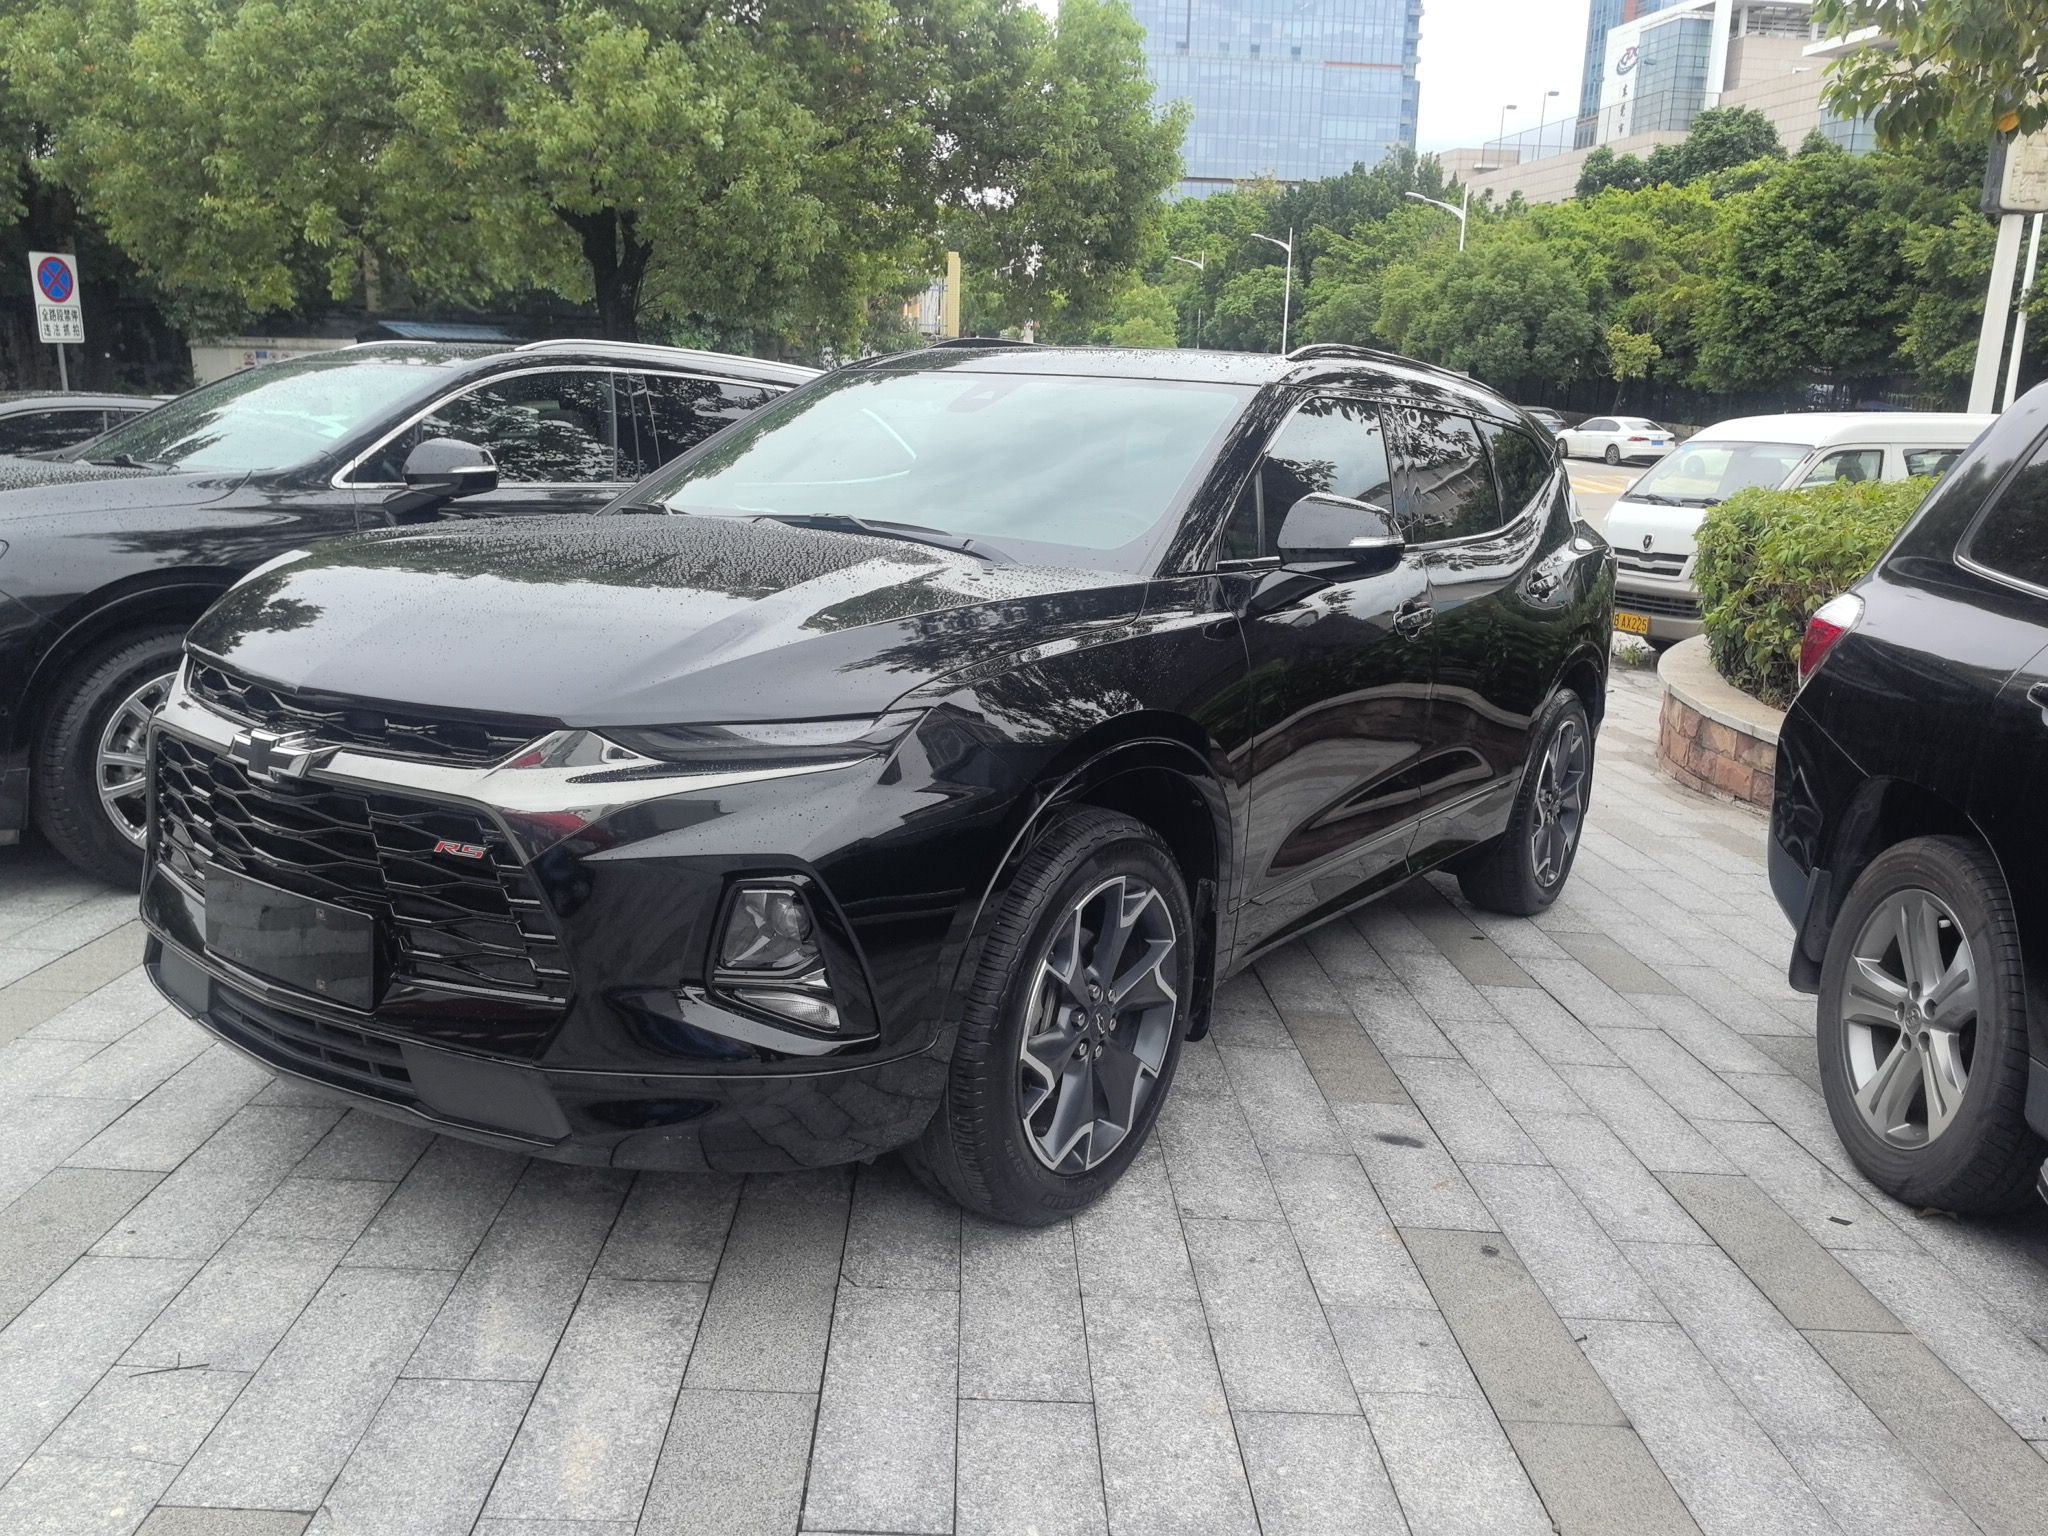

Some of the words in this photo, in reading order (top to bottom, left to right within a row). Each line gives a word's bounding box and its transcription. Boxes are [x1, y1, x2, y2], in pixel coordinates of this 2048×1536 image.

[42, 308, 78, 322] 全路段禁停
[43, 323, 80, 336] 违法抓拍
[434, 840, 487, 859] RS
